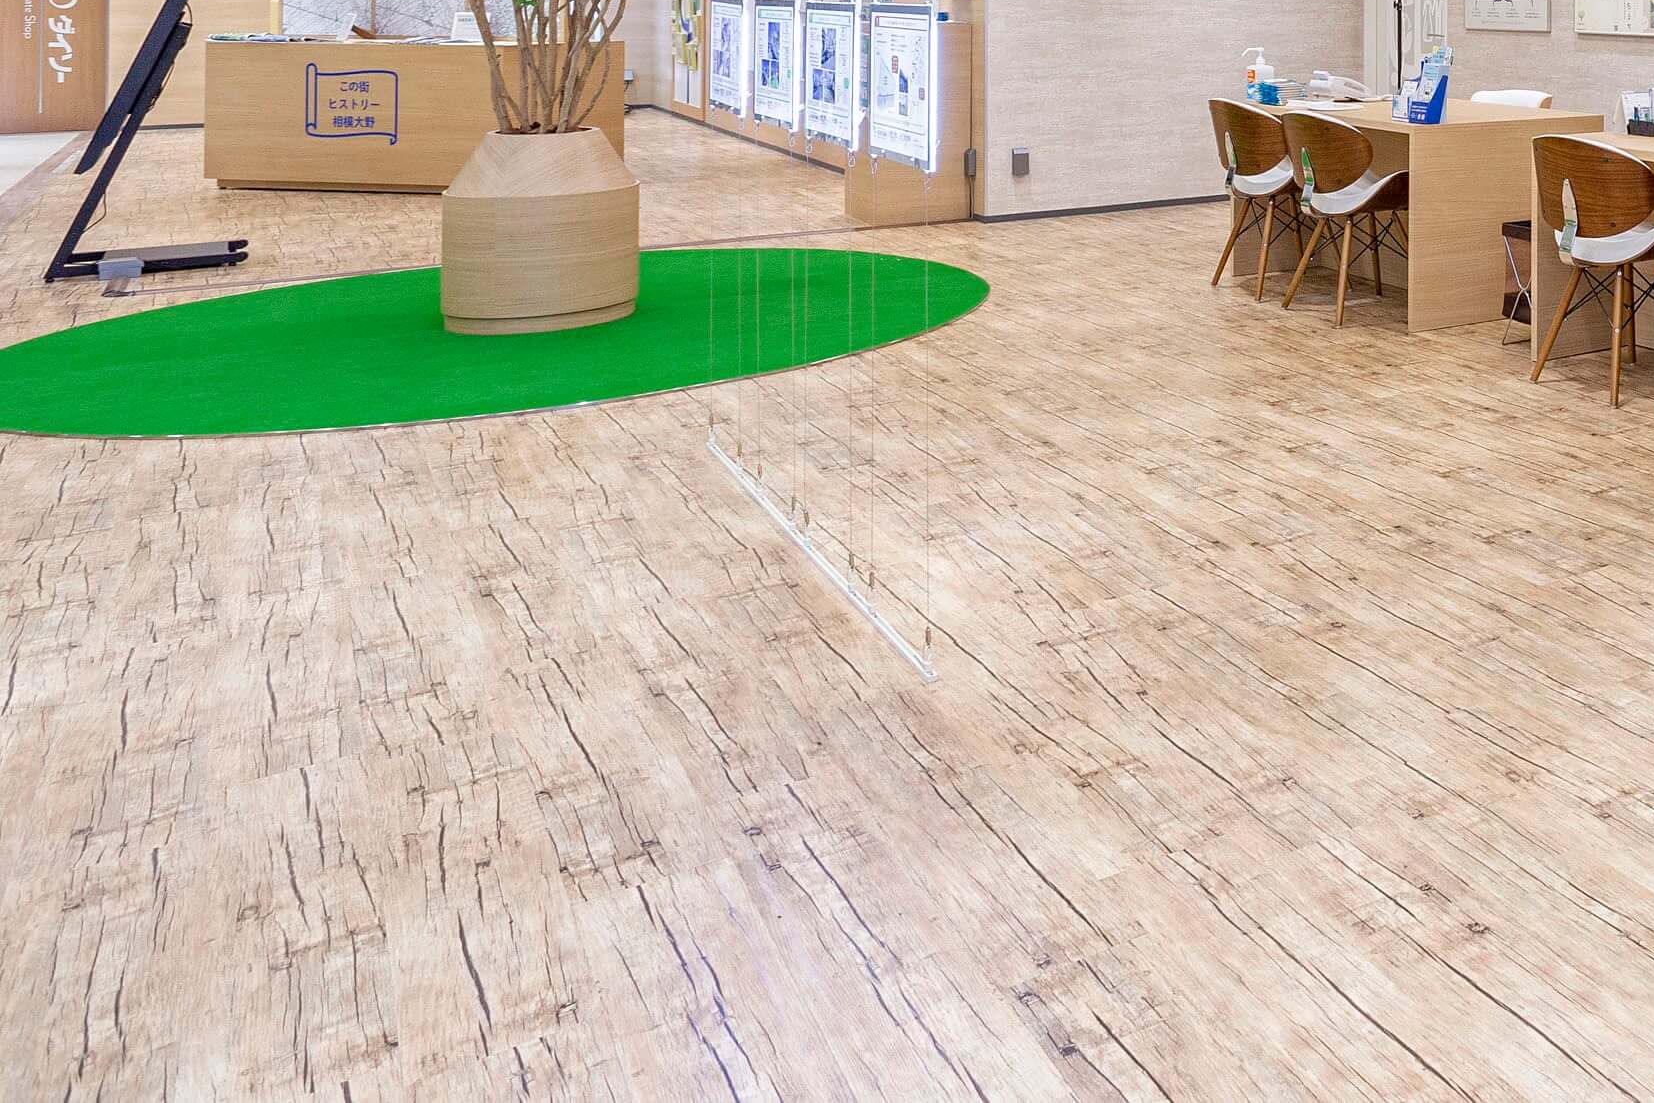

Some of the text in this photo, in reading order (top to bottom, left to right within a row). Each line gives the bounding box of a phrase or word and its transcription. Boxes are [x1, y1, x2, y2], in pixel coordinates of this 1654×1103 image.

[23, 15, 37, 39] Shop
[48, 15, 76, 83] ダイソー
[340, 81, 370, 93] この街
[329, 98, 380, 111] ヒストリー
[333, 115, 375, 128] 相模大野
